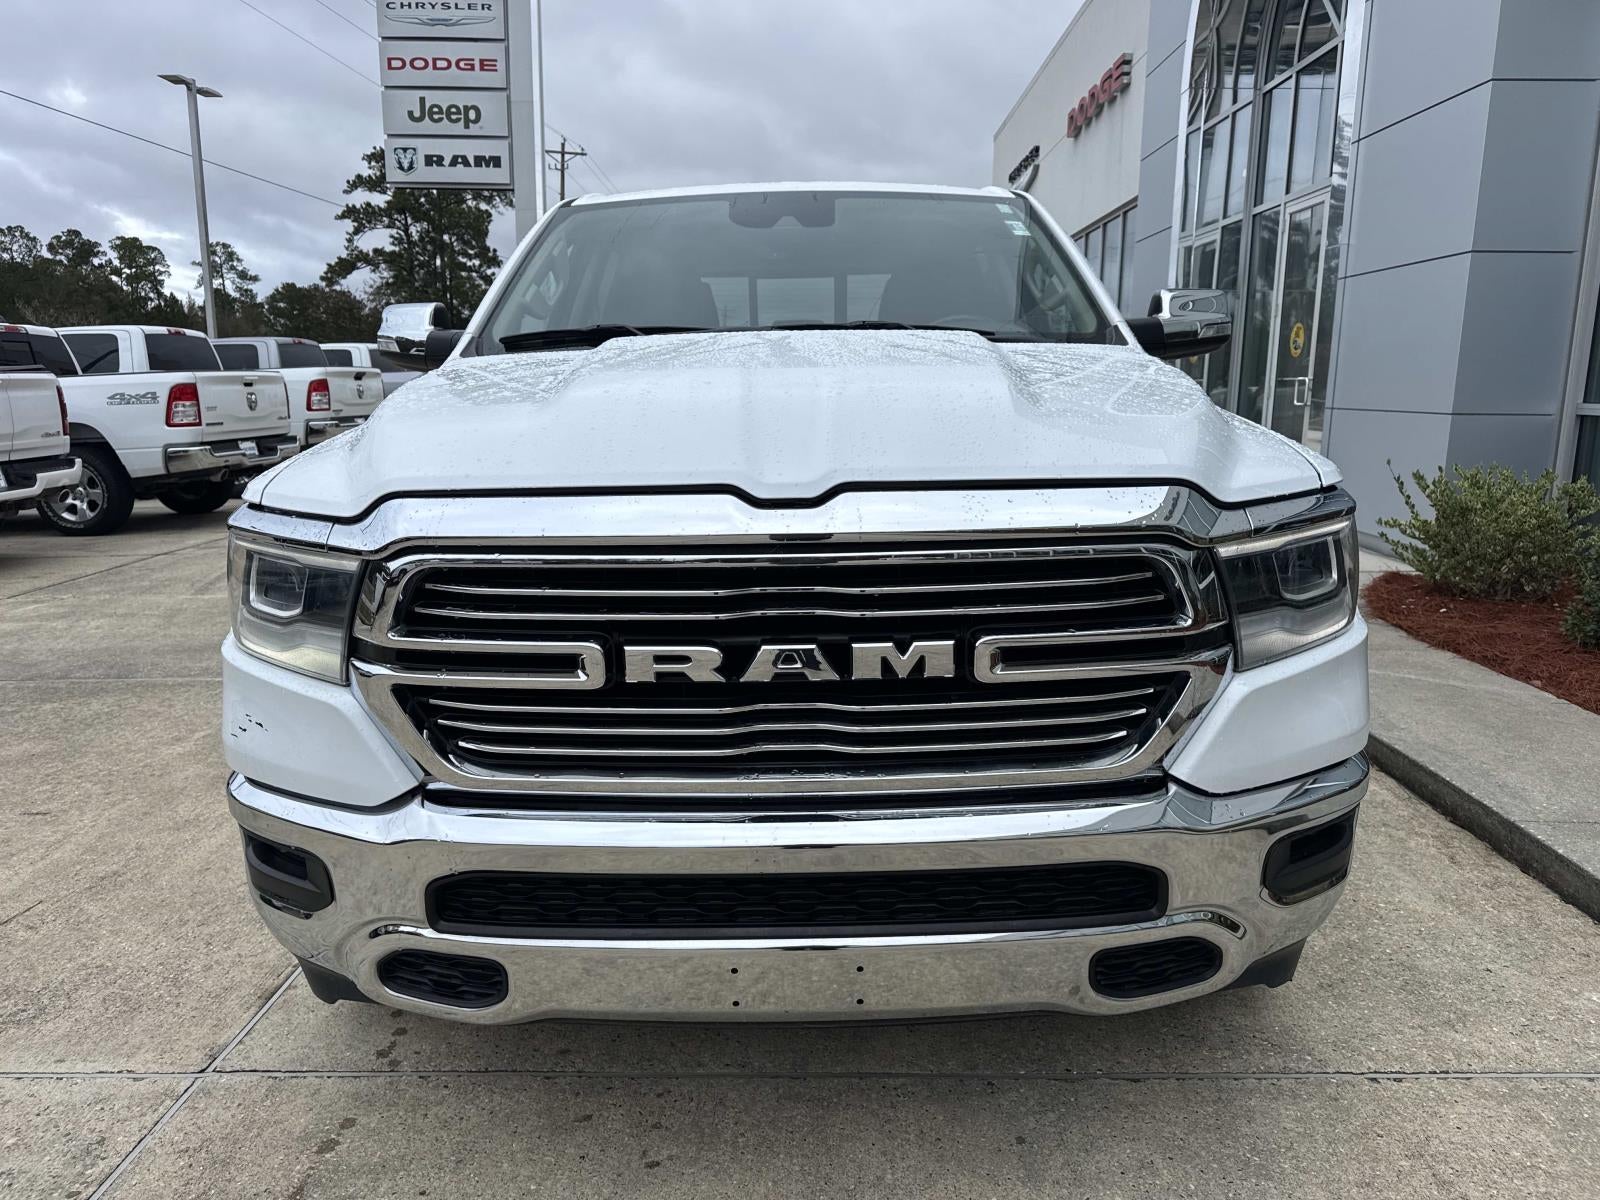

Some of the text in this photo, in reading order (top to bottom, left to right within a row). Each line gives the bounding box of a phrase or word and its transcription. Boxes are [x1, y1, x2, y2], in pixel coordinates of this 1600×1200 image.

[385, 1, 493, 11] CHRYSLER
[387, 57, 498, 72] DODGE
[1066, 52, 1134, 138] DODGE
[407, 96, 482, 129] Jeep
[424, 154, 502, 168] RAM
[623, 640, 956, 683] RAM
